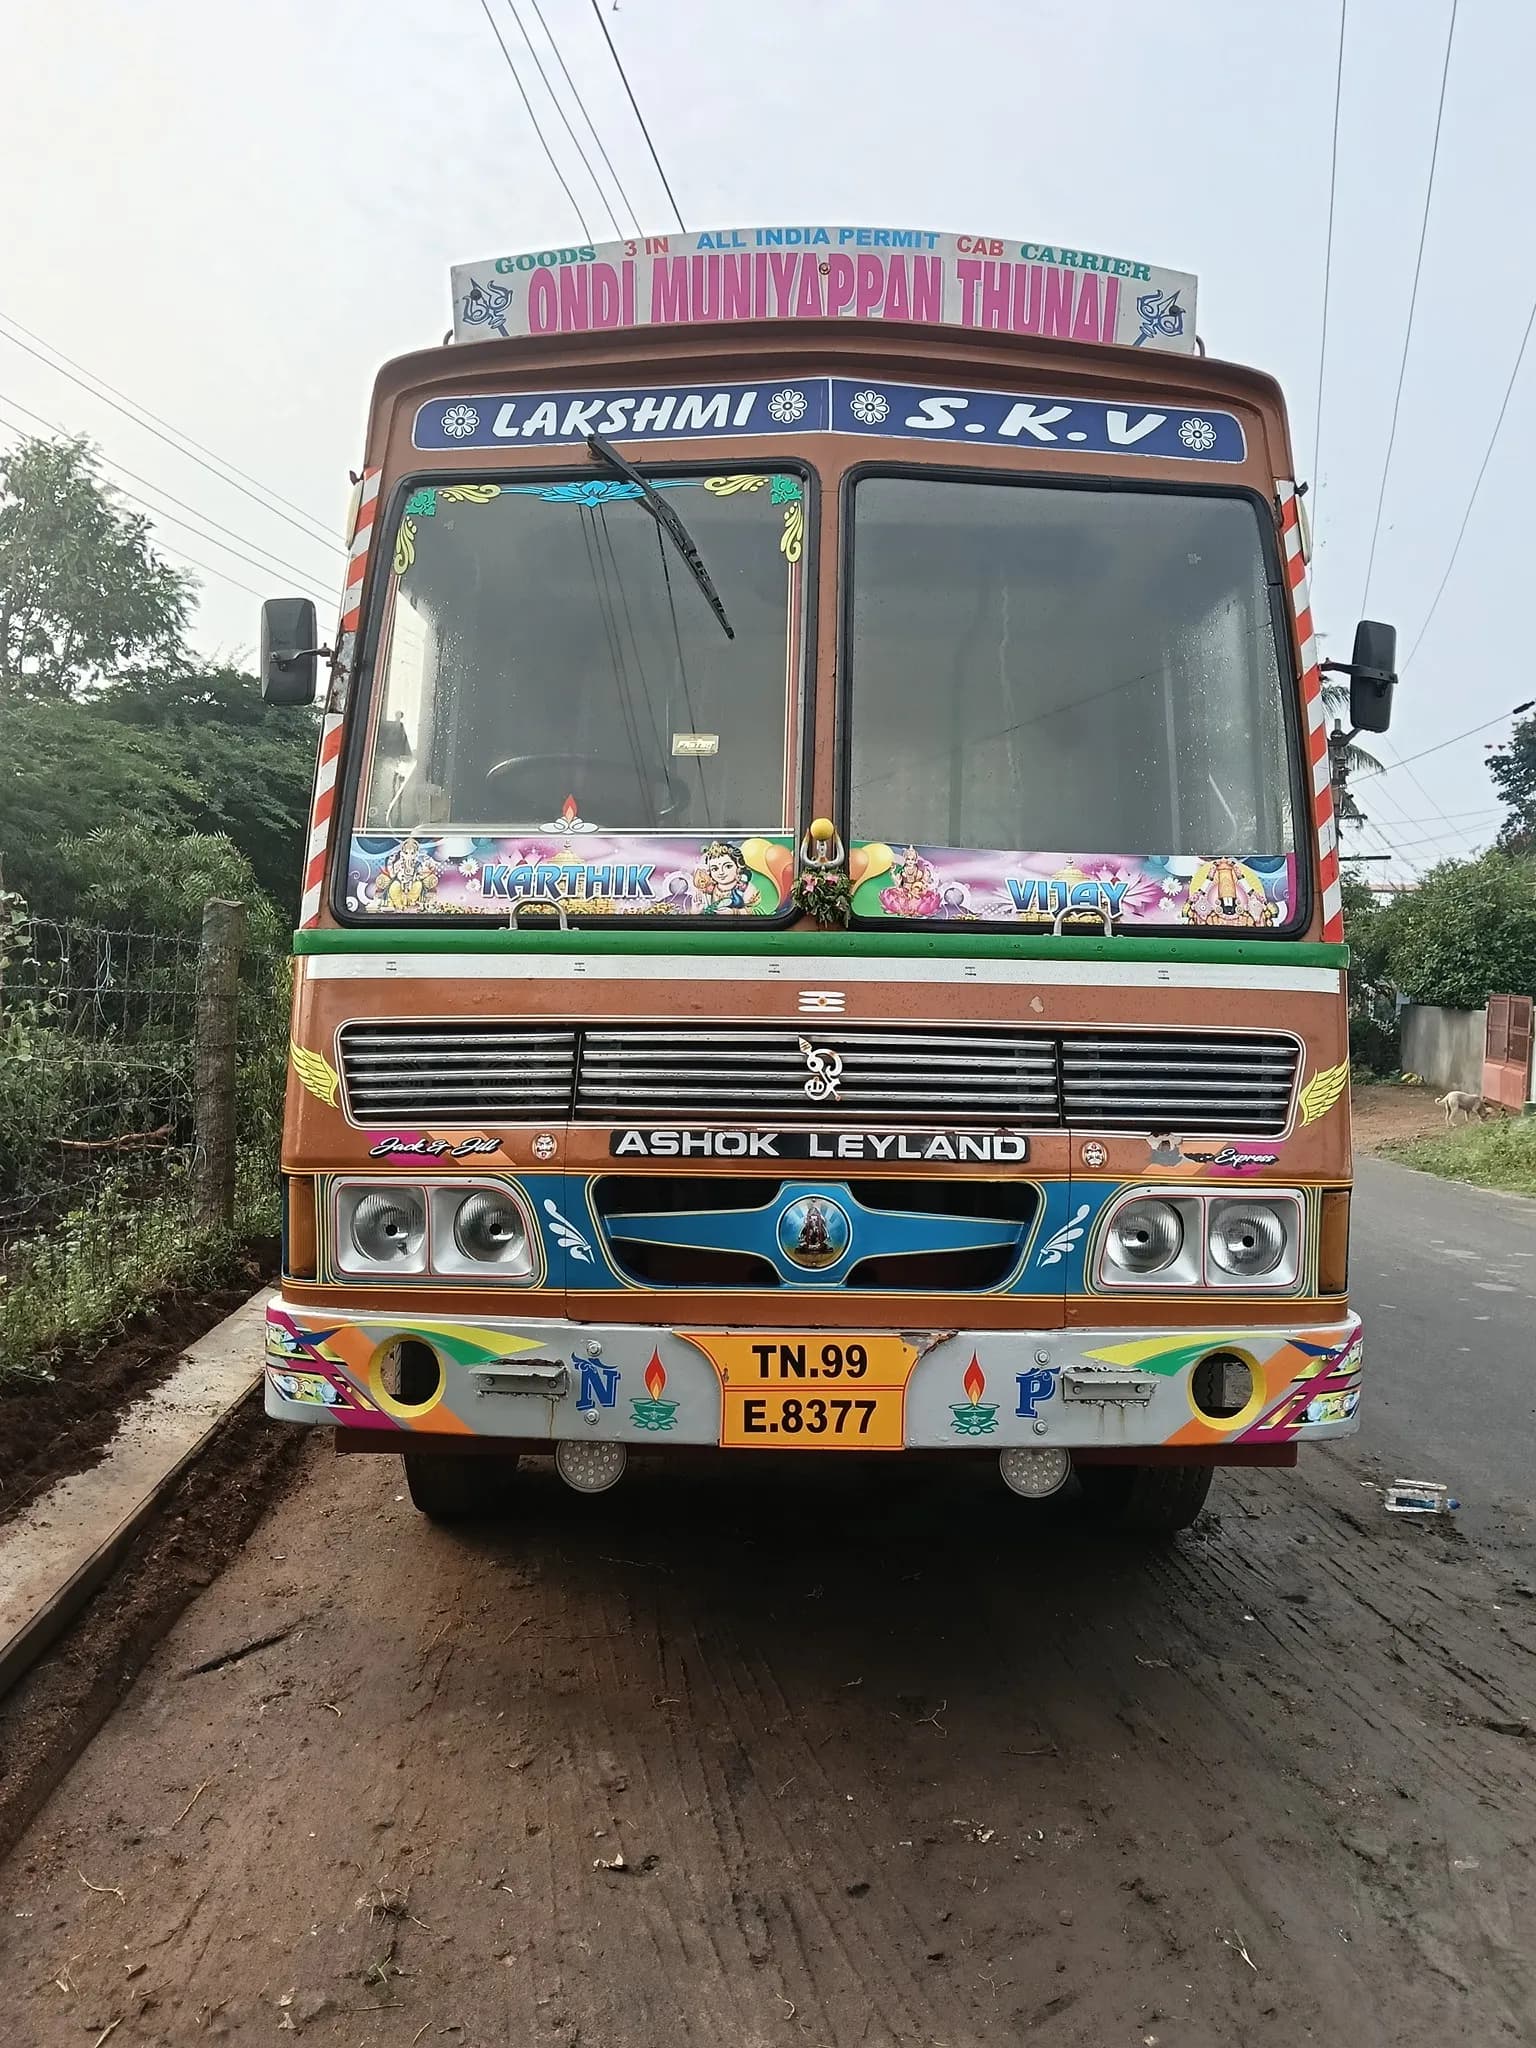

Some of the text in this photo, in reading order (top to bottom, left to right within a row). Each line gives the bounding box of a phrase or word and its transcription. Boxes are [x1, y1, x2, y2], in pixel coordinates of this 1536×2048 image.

[495, 227, 1151, 282] GOODS 3 IN ALL INDIA PERMIT CAB CARRIER
[527, 252, 1121, 344] ONDI MUNIYAPPAN THUNAI
[492, 391, 757, 438] LAKSHMI
[482, 864, 656, 902] KARTHIK
[1006, 878, 1129, 919] VIJAY
[369, 1136, 427, 1157] Jack
[450, 1138, 503, 1157] Jill
[615, 1131, 1027, 1161] ASHOK LEYLAND
[1215, 1148, 1277, 1168] Express
[752, 1344, 868, 1379] TN.99
[572, 1352, 621, 1411] N
[1014, 1366, 1061, 1418] P
[743, 1399, 877, 1433] E.8377
